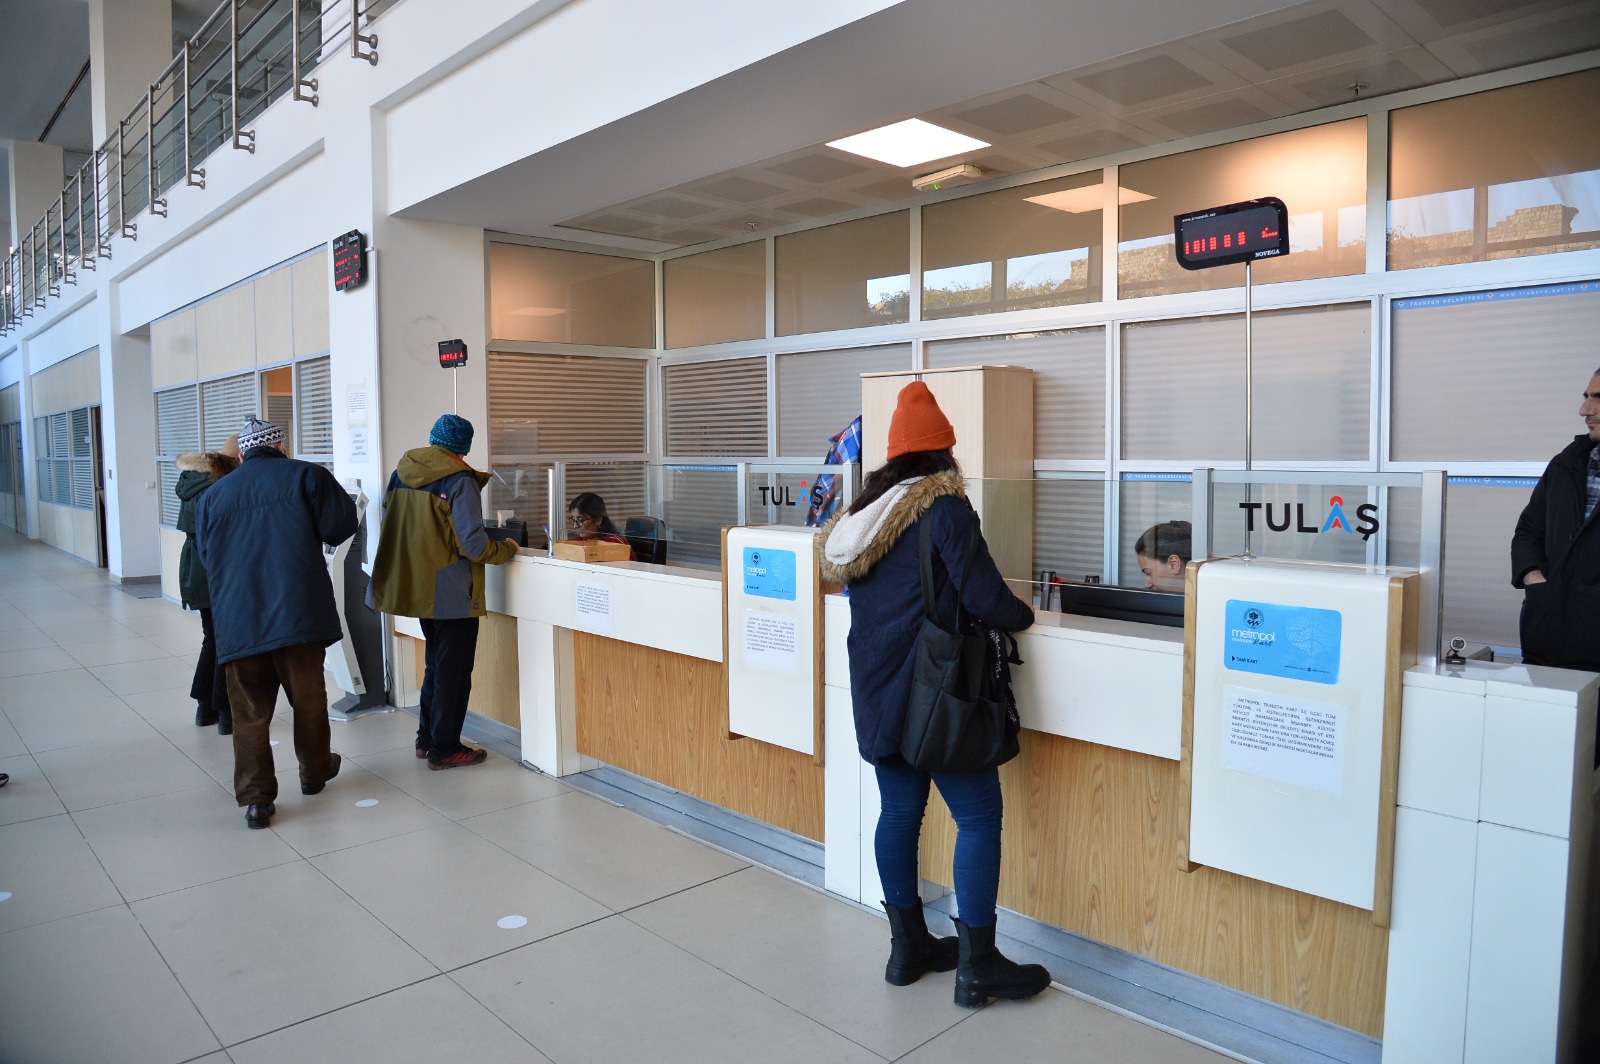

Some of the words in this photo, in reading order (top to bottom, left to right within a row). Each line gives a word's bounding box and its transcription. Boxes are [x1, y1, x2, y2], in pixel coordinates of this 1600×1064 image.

[1254, 248, 1280, 258] NOVEGA
[758, 480, 824, 510] TULAŞ
[1239, 496, 1380, 541] TULAŞ
[1231, 629, 1276, 642] metropol
